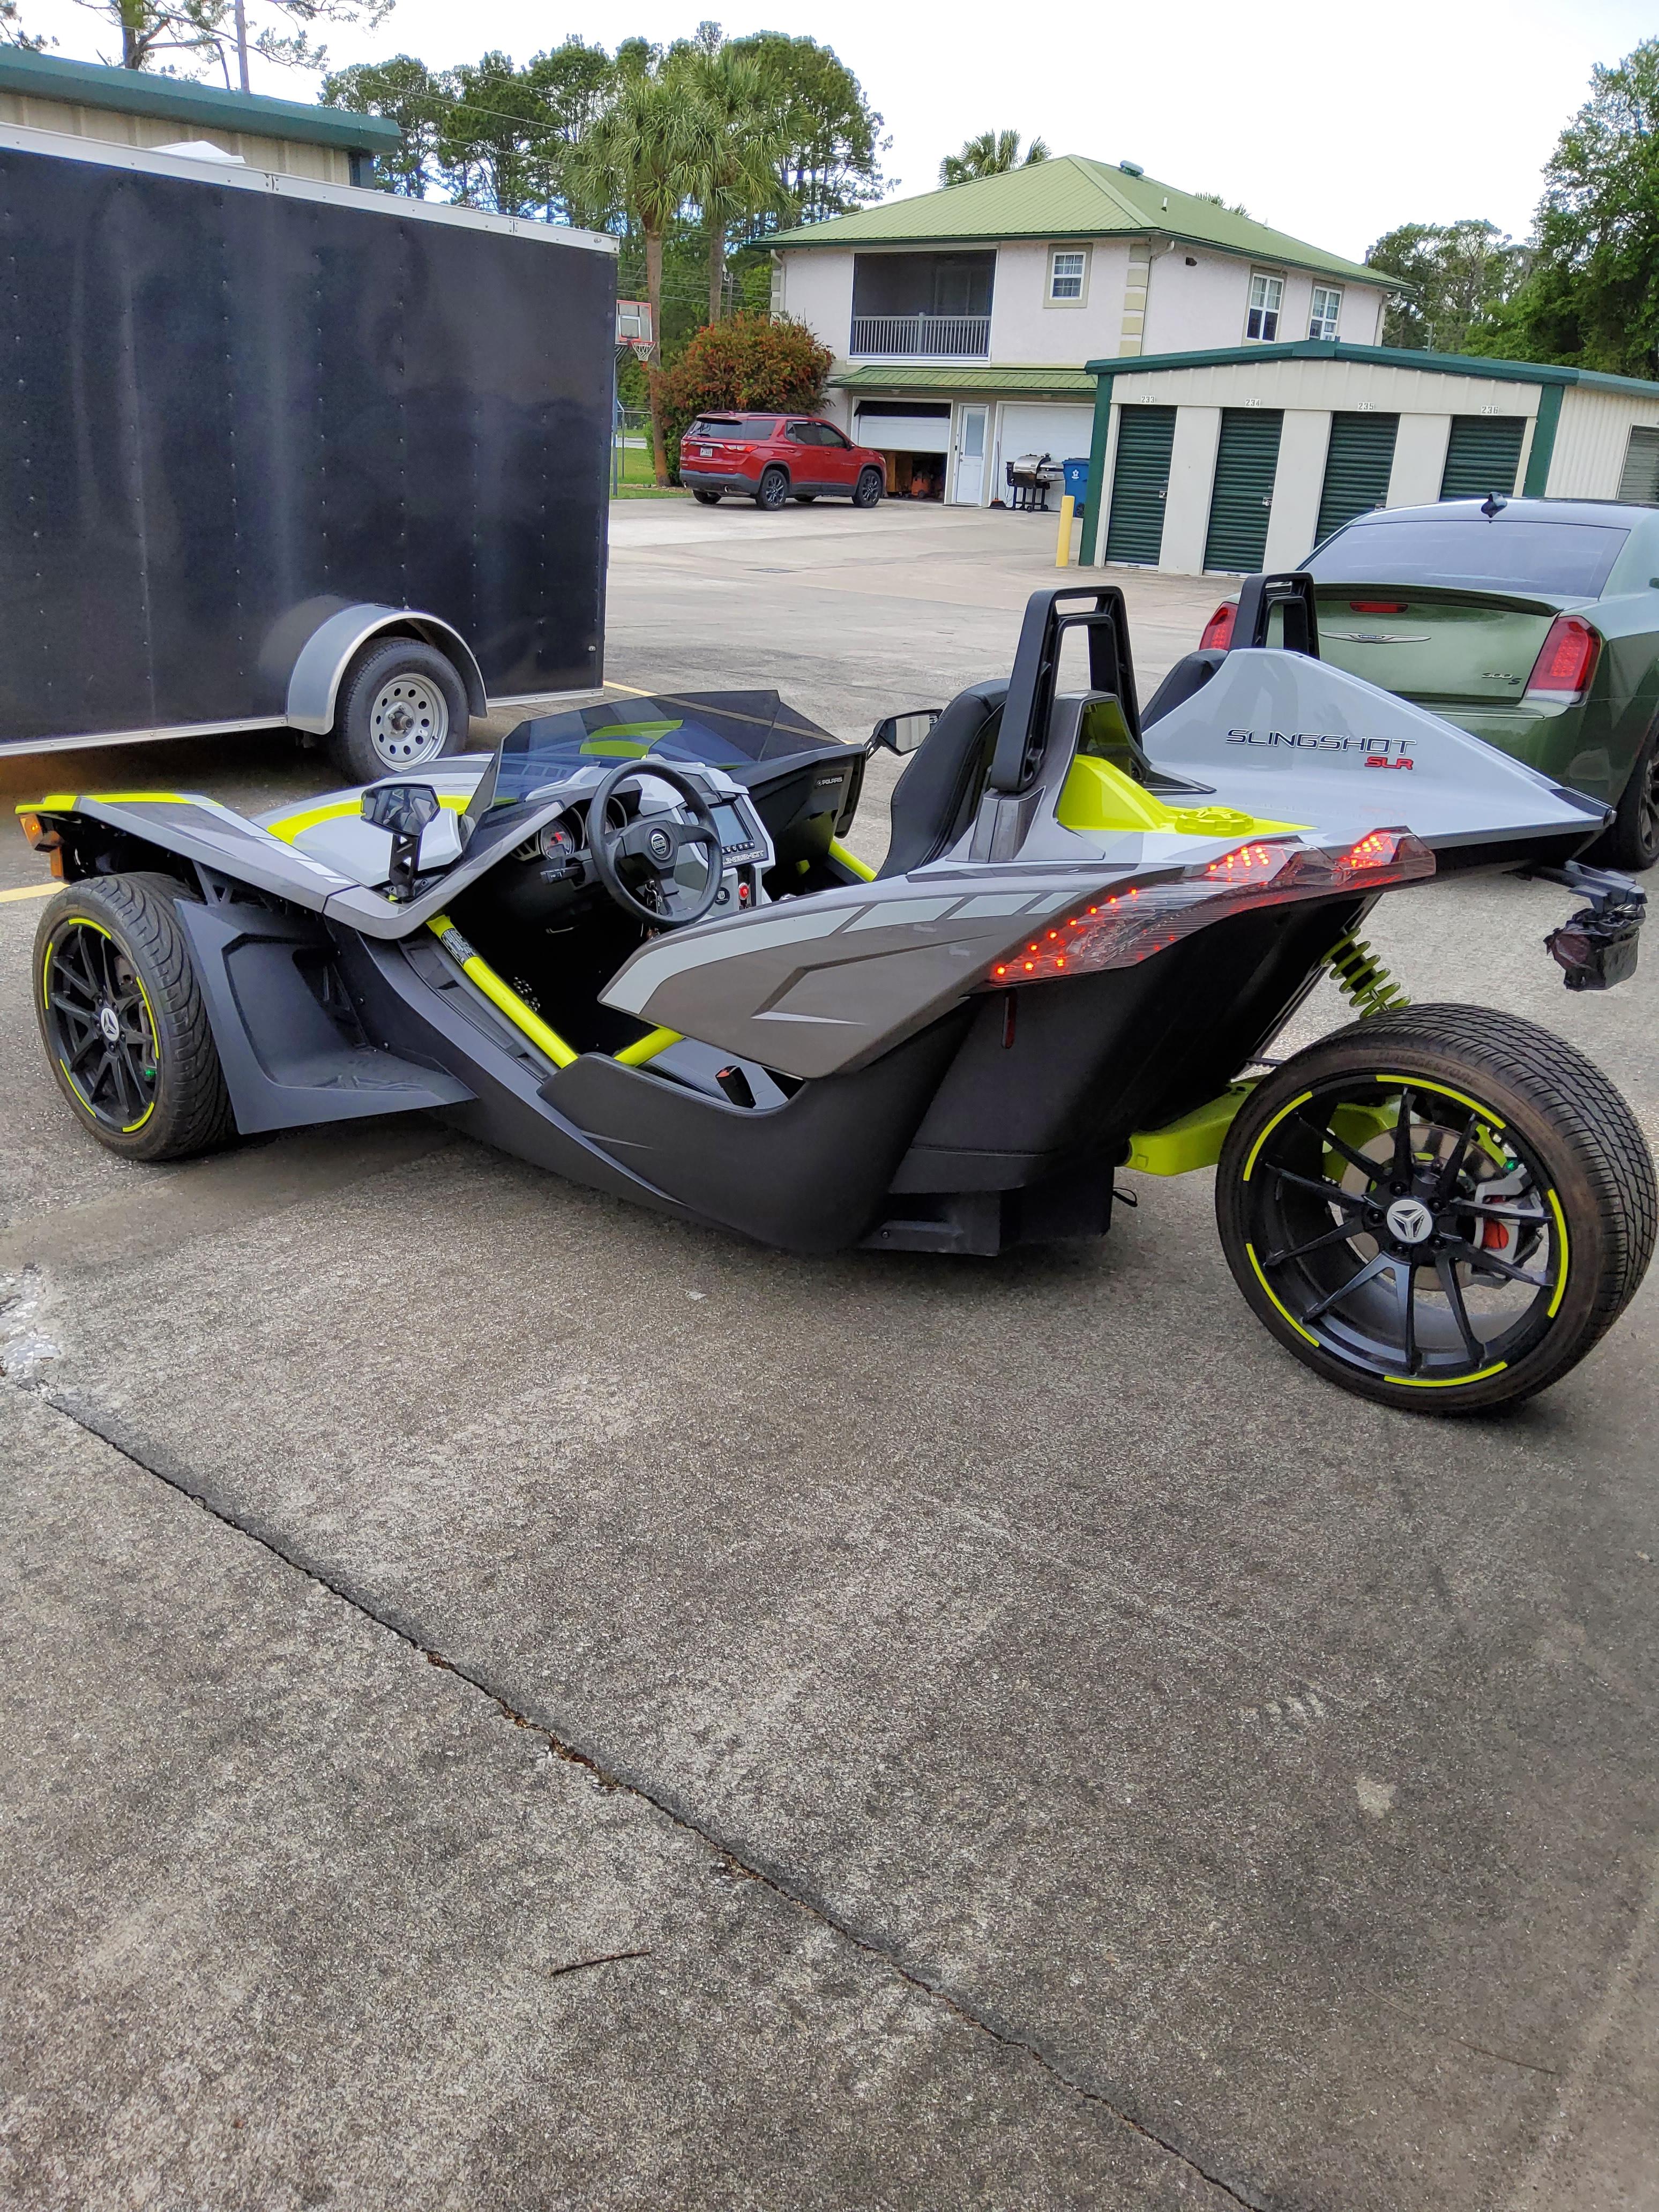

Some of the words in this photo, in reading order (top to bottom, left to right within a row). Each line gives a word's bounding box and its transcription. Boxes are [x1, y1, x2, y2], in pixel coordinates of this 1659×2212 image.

[1225, 728, 1417, 755] SLINGSHOT
[1364, 756, 1414, 770] SLR
[821, 776, 843, 785] POLARIS
